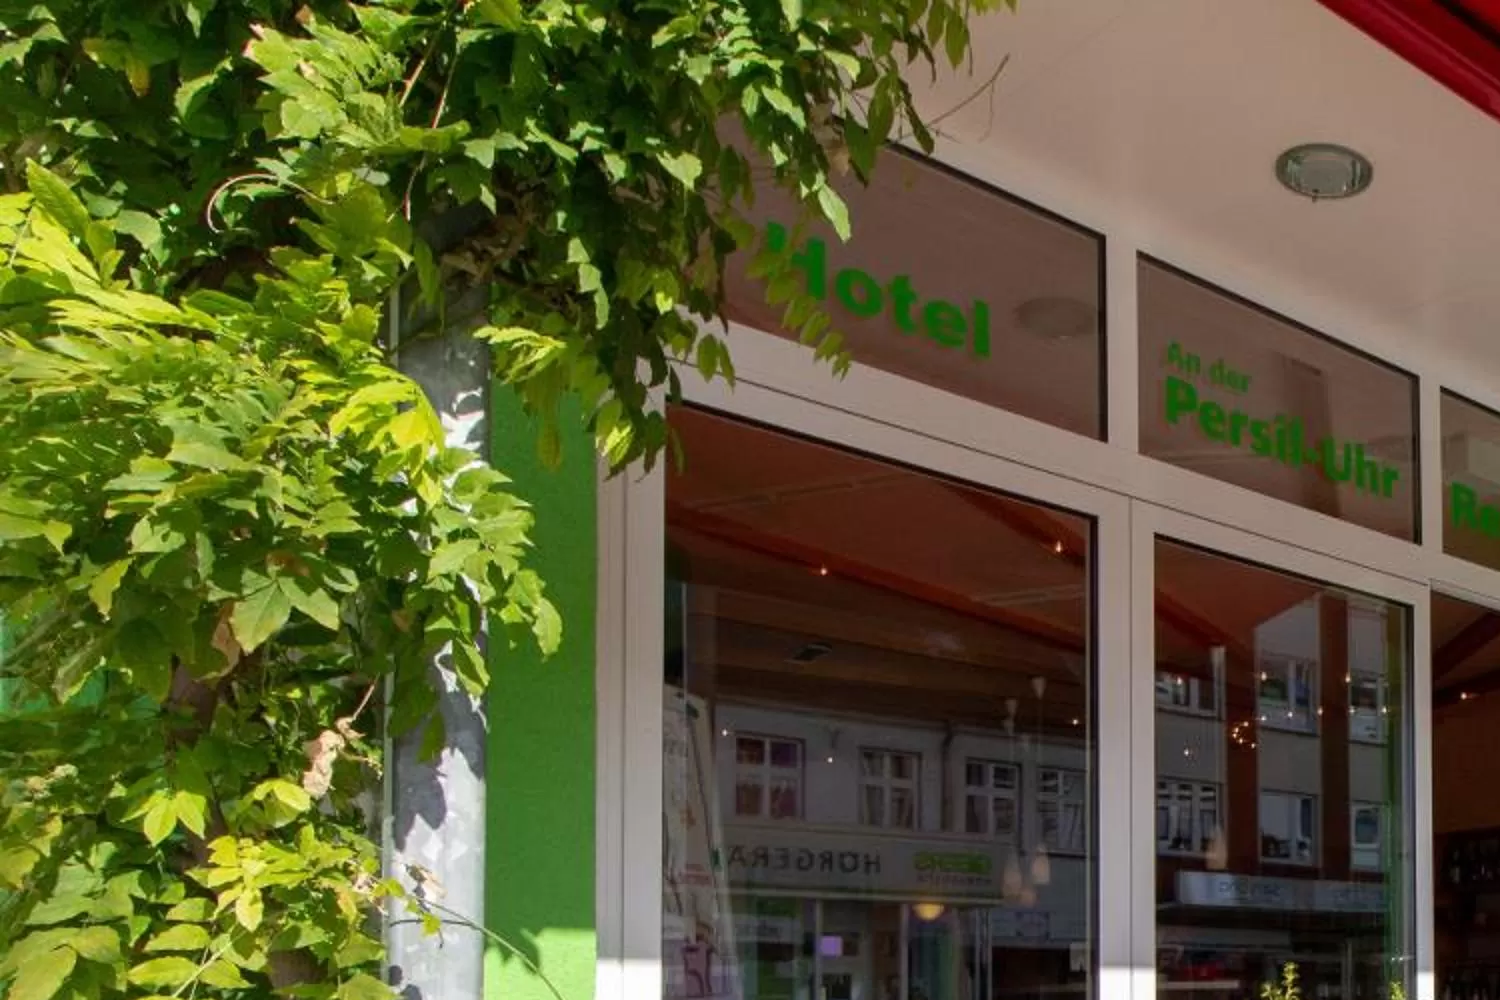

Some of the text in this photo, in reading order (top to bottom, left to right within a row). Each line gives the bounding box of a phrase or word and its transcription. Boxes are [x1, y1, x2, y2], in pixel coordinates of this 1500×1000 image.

[767, 220, 991, 358] Hotel
[1166, 341, 1252, 393] An der
[1165, 375, 1399, 498] Persil-Uhr
